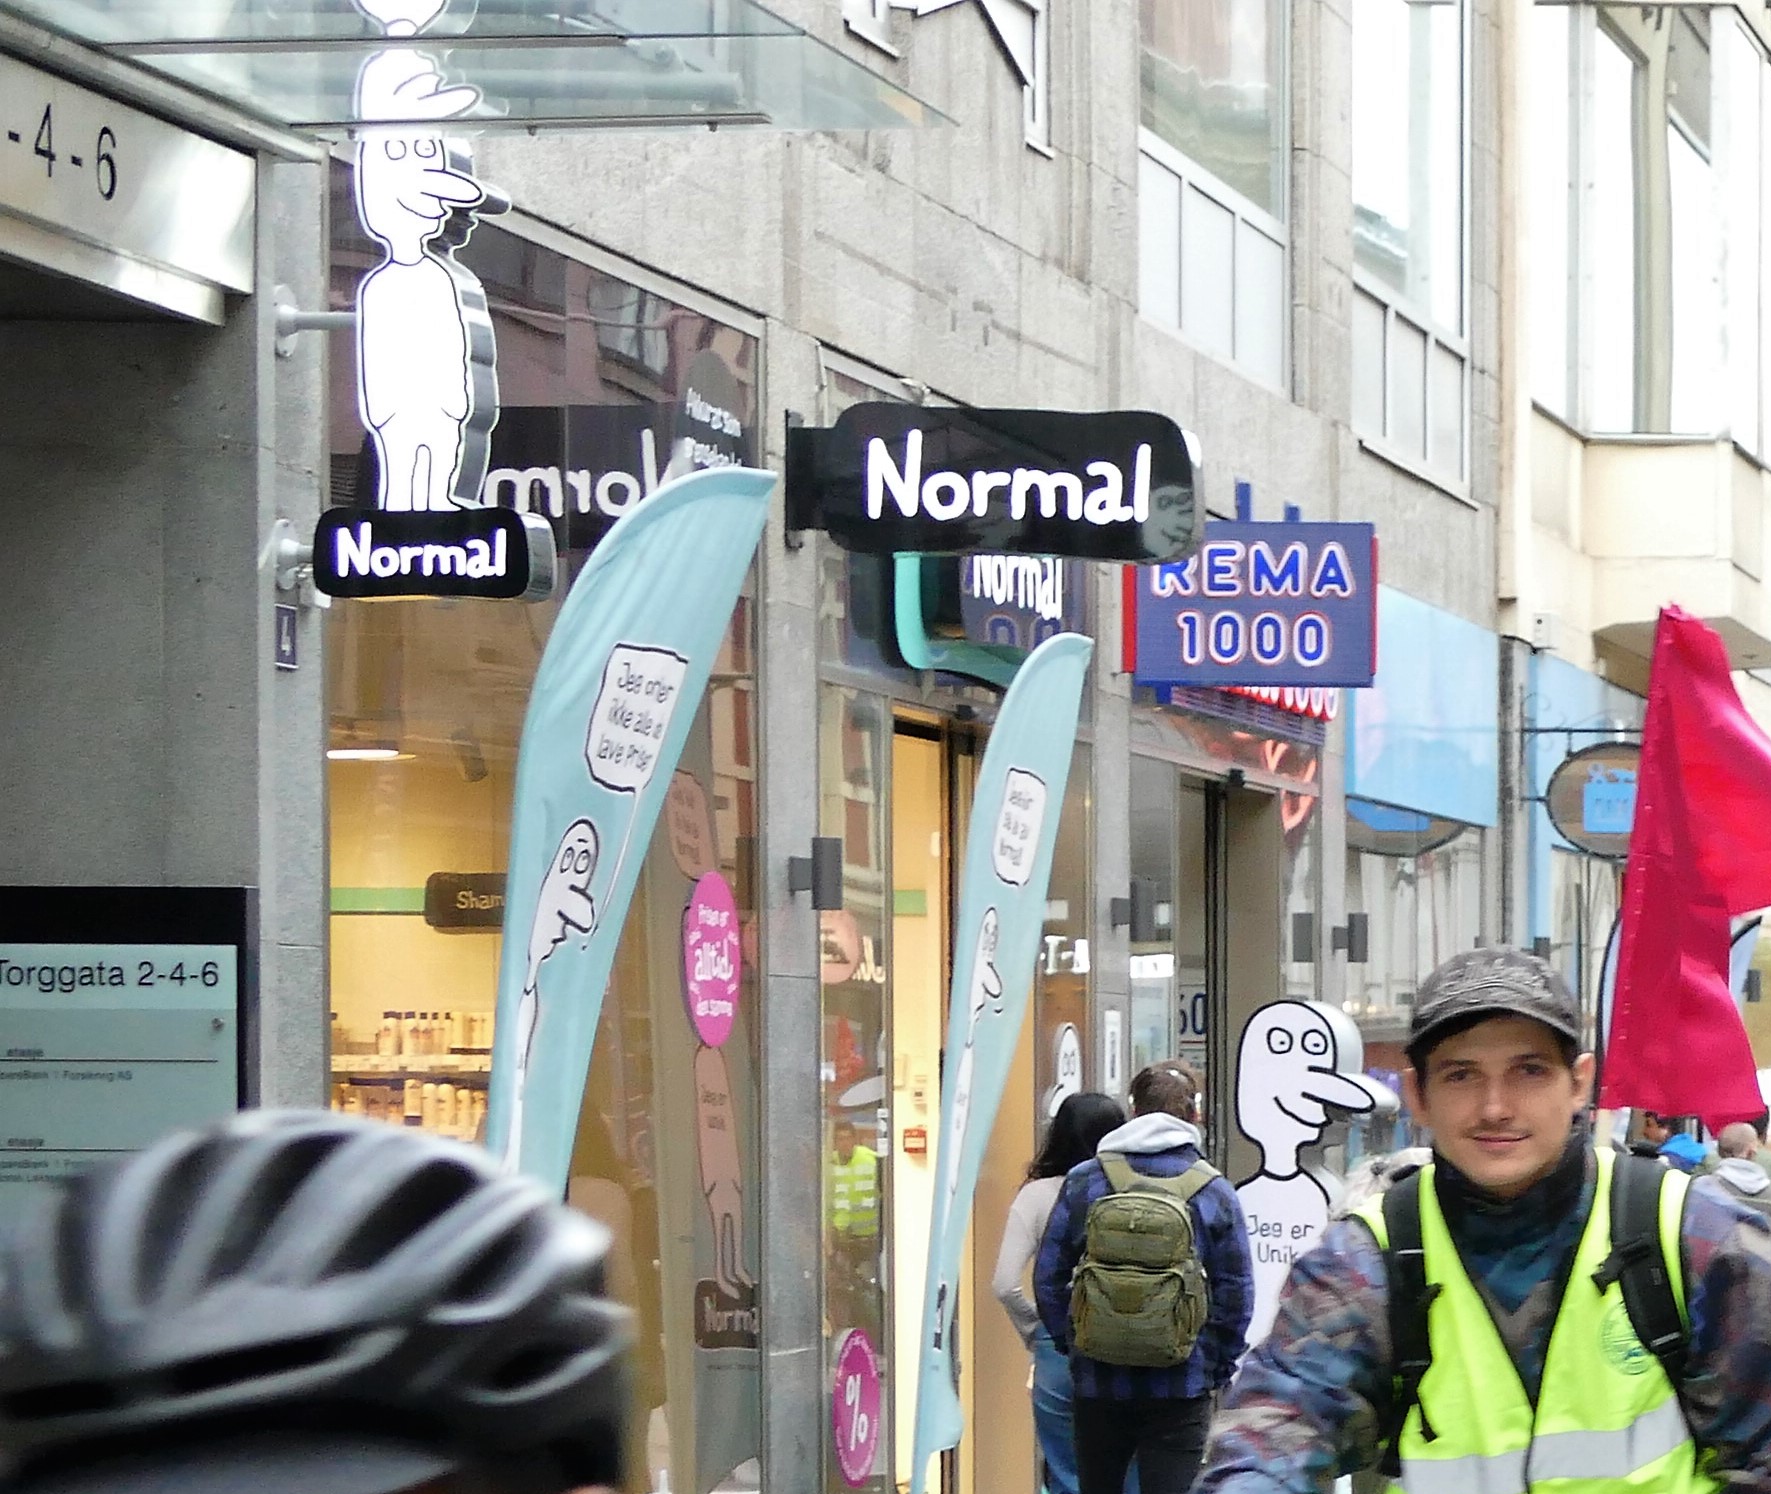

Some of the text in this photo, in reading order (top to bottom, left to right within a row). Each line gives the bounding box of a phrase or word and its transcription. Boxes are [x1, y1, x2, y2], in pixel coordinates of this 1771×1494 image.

[866, 429, 1151, 523] Normal
[336, 526, 506, 578] Normal
[1152, 540, 1356, 599] REMA
[973, 555, 1062, 621] Normal
[1177, 610, 1333, 668] 1000
[0, 959, 220, 994] Torggata 2-4-6
[1247, 1214, 1315, 1240] Jeg er
